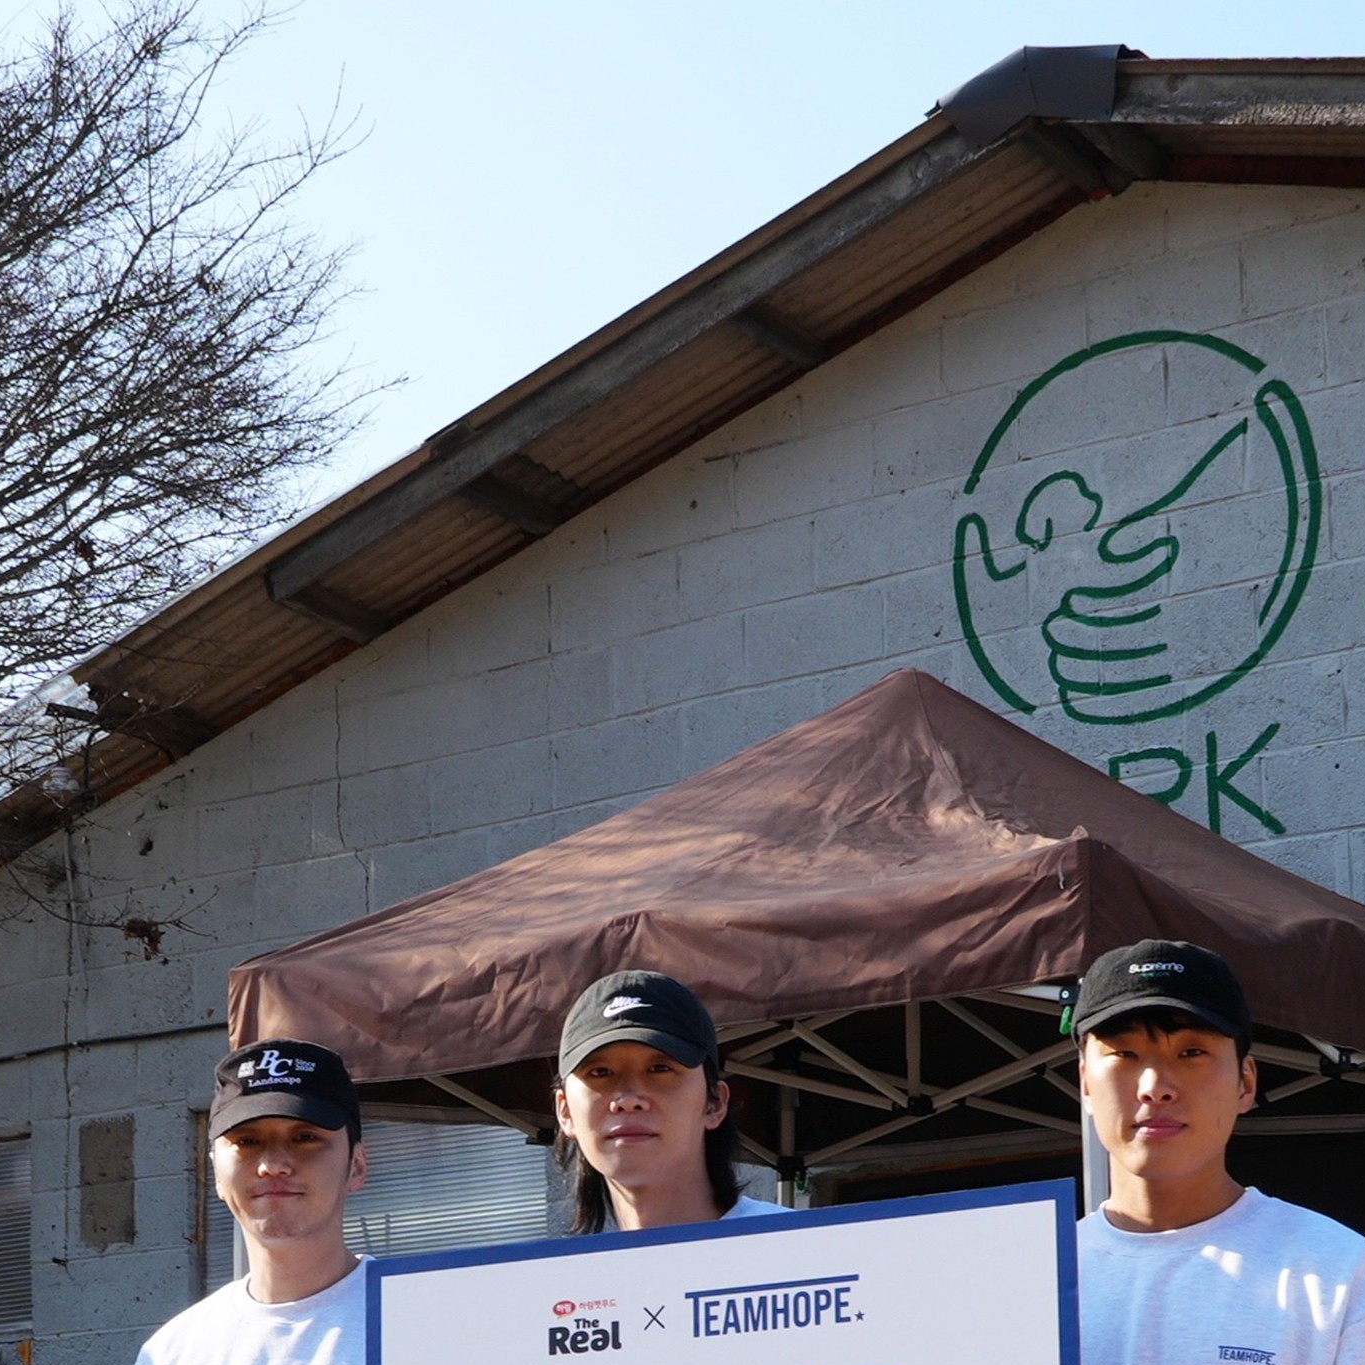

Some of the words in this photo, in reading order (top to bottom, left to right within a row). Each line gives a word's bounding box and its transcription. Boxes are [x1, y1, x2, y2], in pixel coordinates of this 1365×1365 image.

[1128, 961, 1185, 973] supreme
[248, 1076, 302, 1088] Landscape
[574, 1318, 600, 1329] The
[548, 1321, 622, 1355] Real
